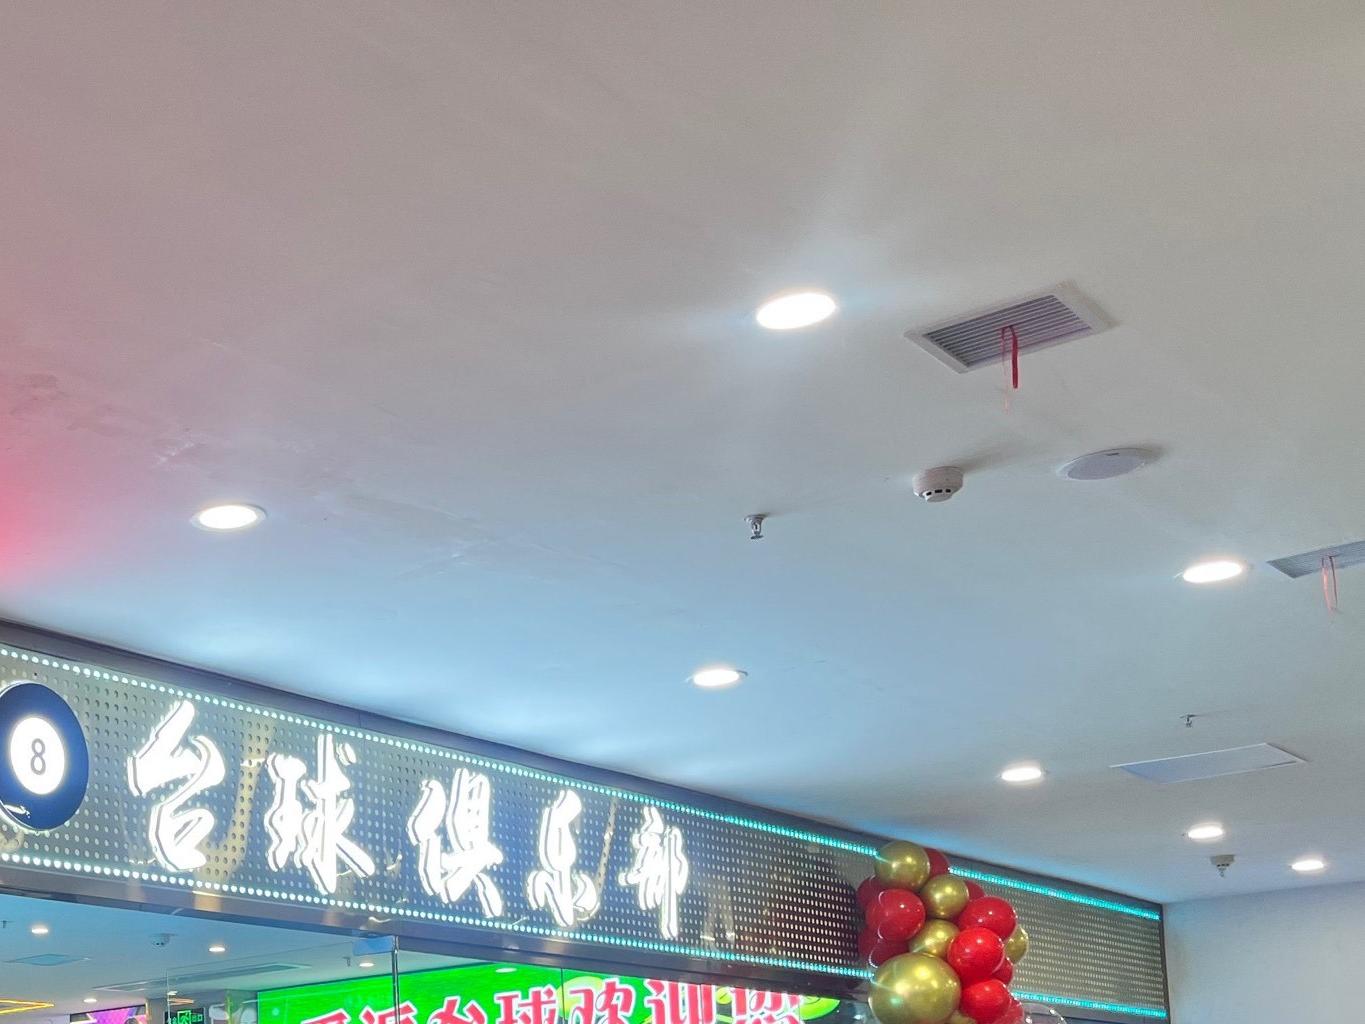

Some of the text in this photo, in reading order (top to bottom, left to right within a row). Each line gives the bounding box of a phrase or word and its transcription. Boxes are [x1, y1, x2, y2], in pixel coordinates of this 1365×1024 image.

[30, 739, 47, 776] 8
[127, 700, 689, 941] 台球俱乐部
